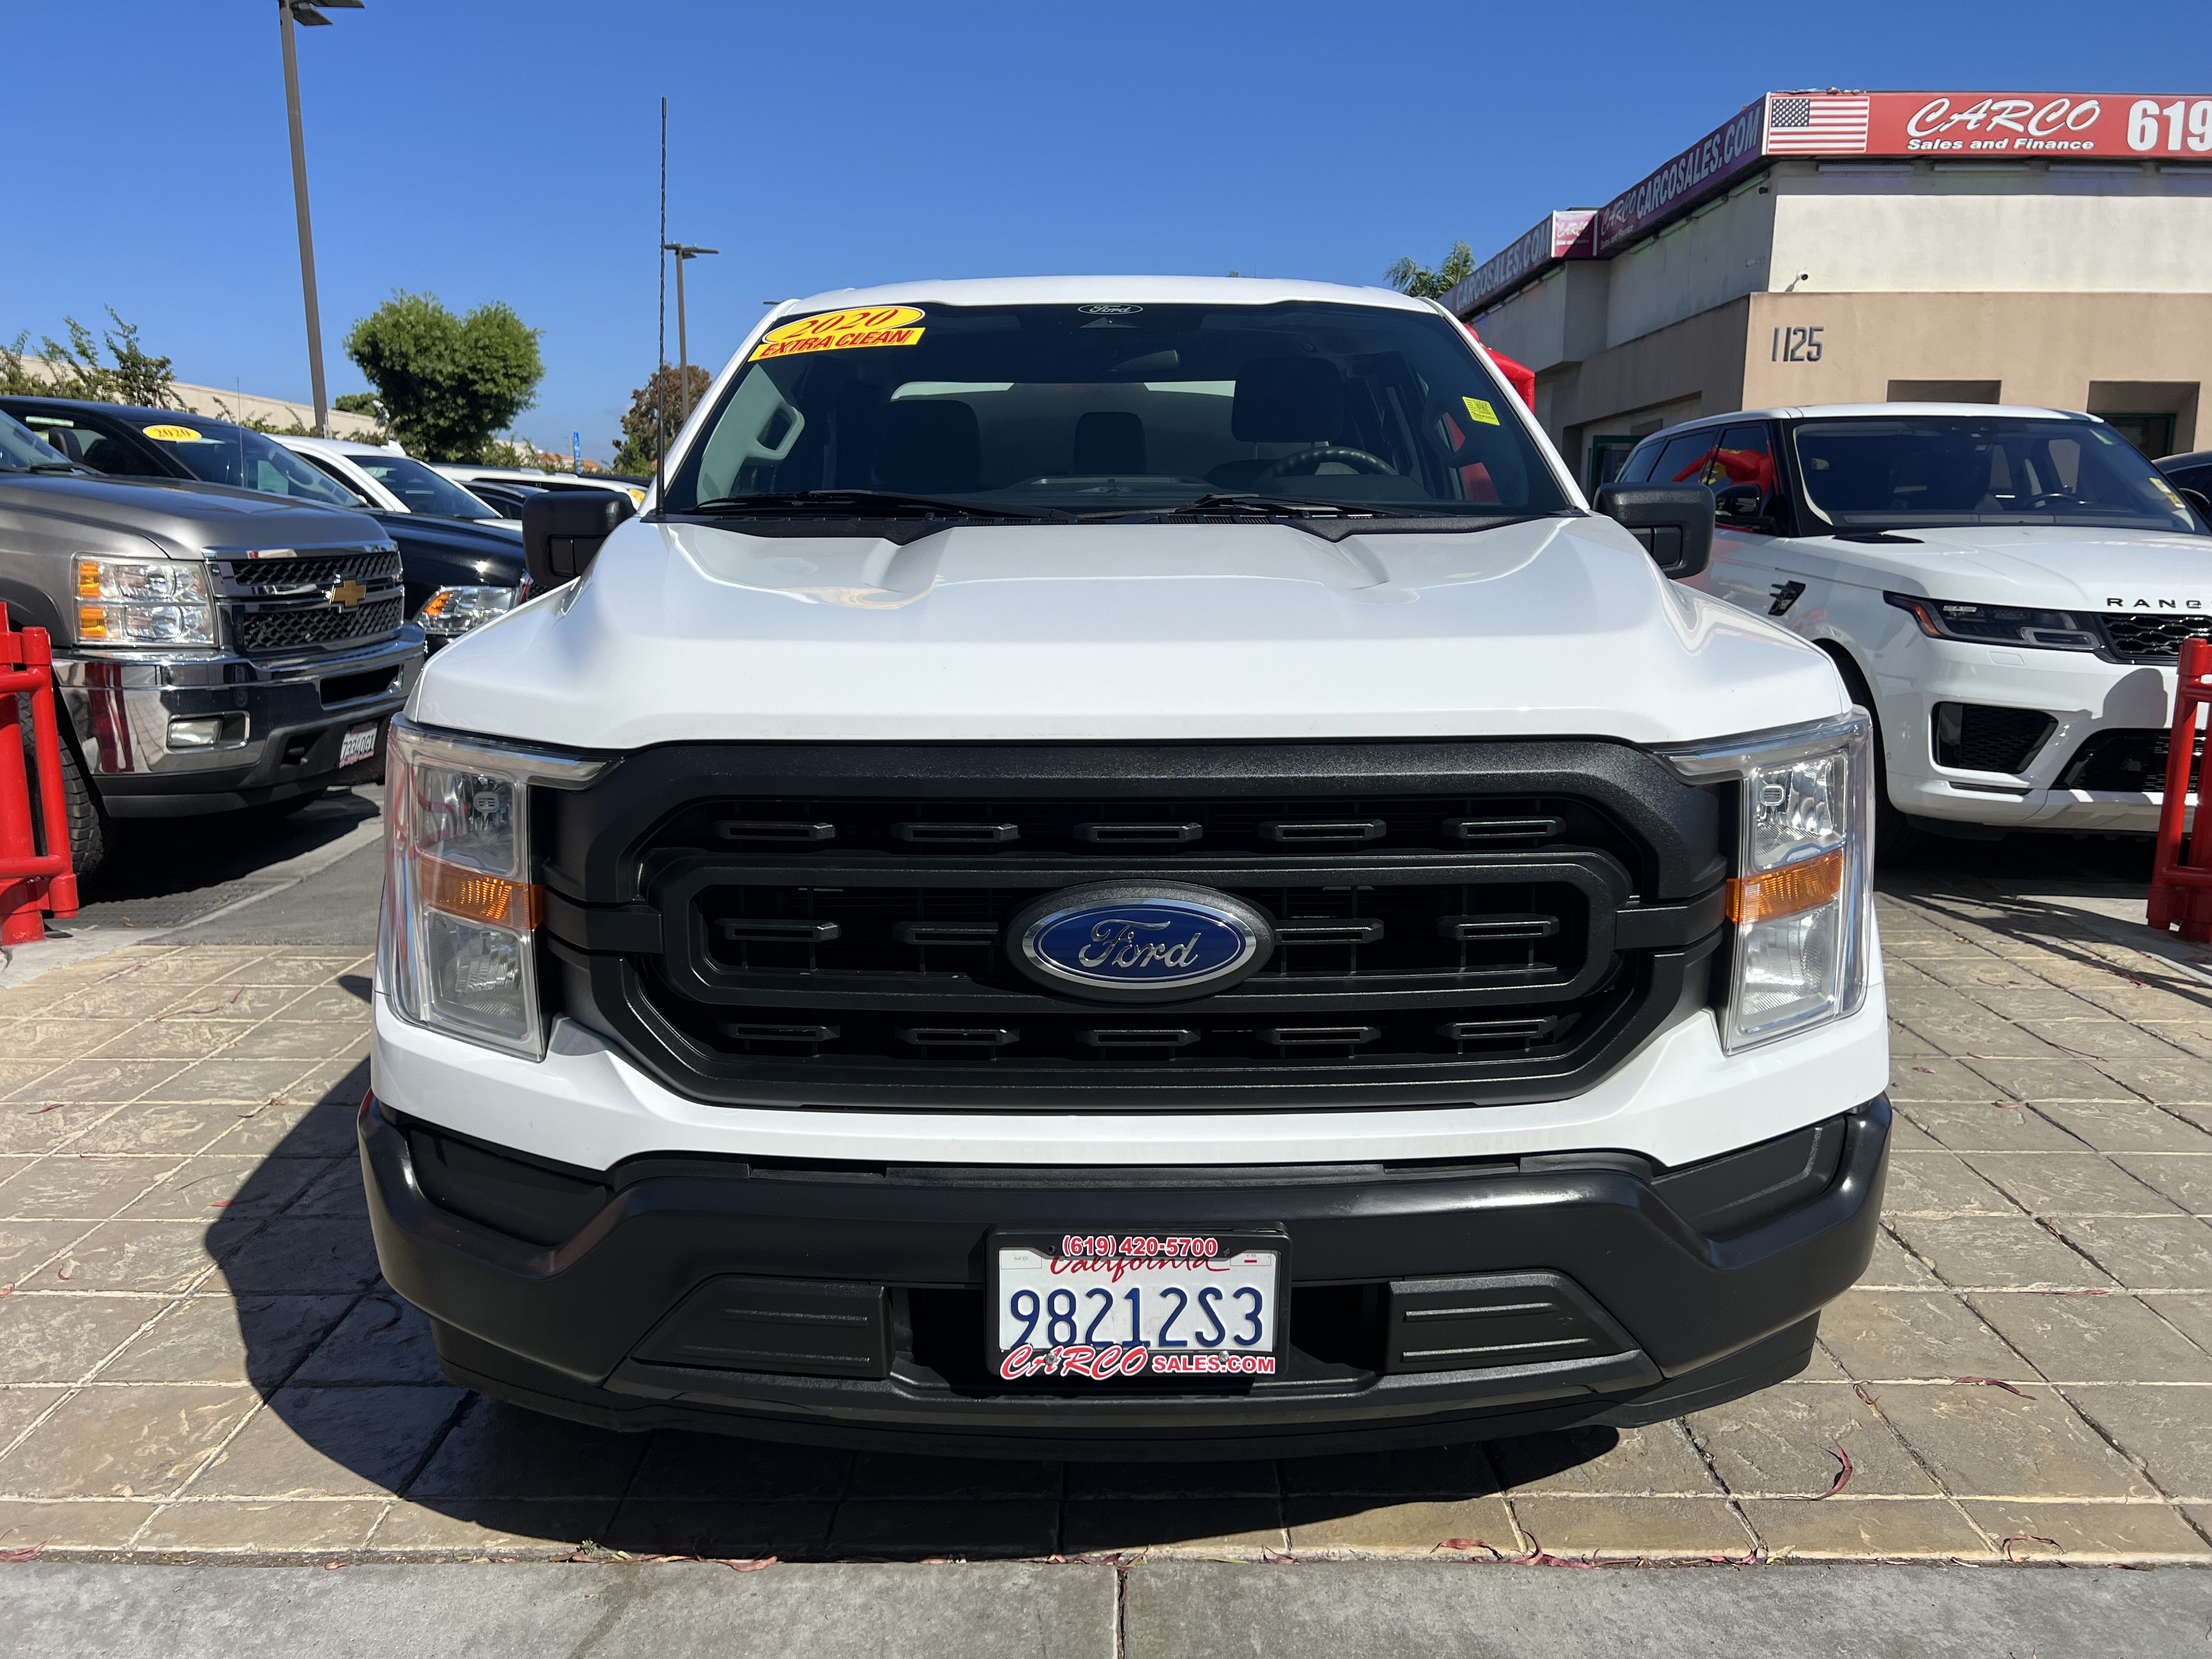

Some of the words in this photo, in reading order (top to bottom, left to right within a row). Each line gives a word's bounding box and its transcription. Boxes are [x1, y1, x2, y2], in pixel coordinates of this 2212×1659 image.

[1906, 98, 2101, 137] CARCO
[2127, 99, 2212, 151] 619
[1908, 138, 1963, 150] Sales
[1970, 138, 2008, 150] and
[2014, 138, 2095, 150] Finance
[1637, 106, 1761, 219] CARCOSALES.COM
[1457, 220, 1551, 311] CARCOSALES.COM
[781, 309, 899, 341] 2020
[1089, 304, 1132, 313] Ford
[759, 335, 836, 359] EXTRA
[835, 329, 915, 347] CLEAN
[1771, 326, 1824, 362] 1125
[154, 428, 190, 437] 2020
[2107, 597, 2212, 608] RANG
[1078, 918, 1201, 968] Ford
[1062, 1235, 1116, 1257] (619)
[1119, 1236, 1218, 1257] 420-5700
[1050, 1256, 1231, 1283] California
[1009, 1286, 1263, 1351] 98212S3
[1000, 1344, 1148, 1380] CARCO
[1152, 1355, 1276, 1374] SALES.COM
